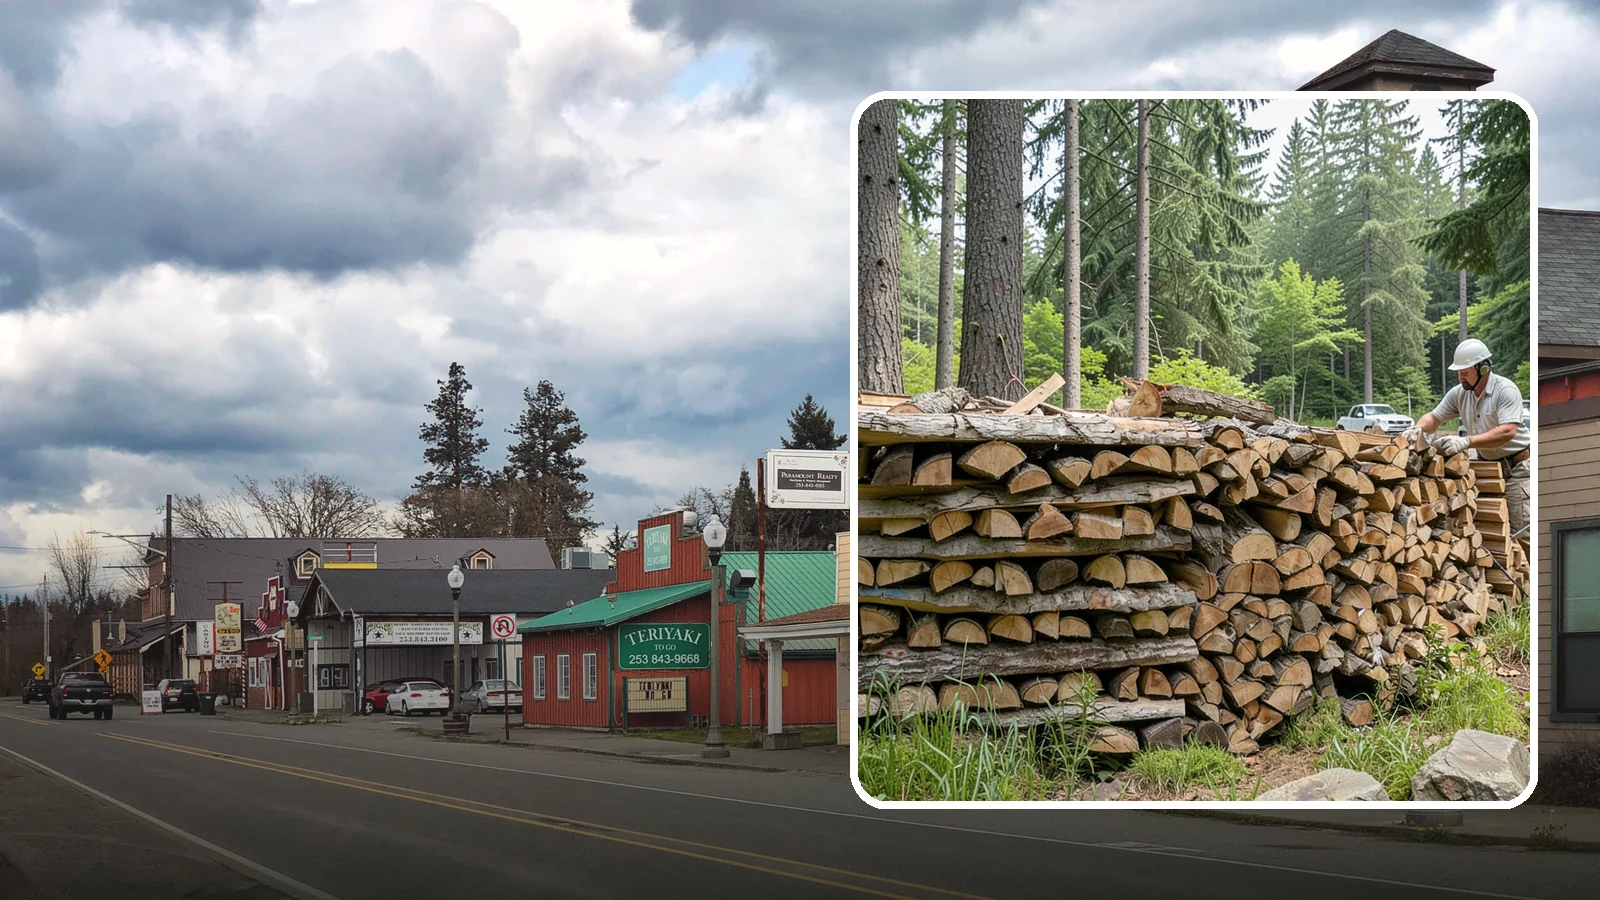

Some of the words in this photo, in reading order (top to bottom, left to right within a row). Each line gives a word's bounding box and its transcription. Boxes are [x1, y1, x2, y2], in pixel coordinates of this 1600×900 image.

[625, 627, 702, 646] TERIYAKI
[628, 654, 649, 665] 253
[651, 653, 700, 664] 843-9668
[639, 681, 672, 690] TERIYAKI
